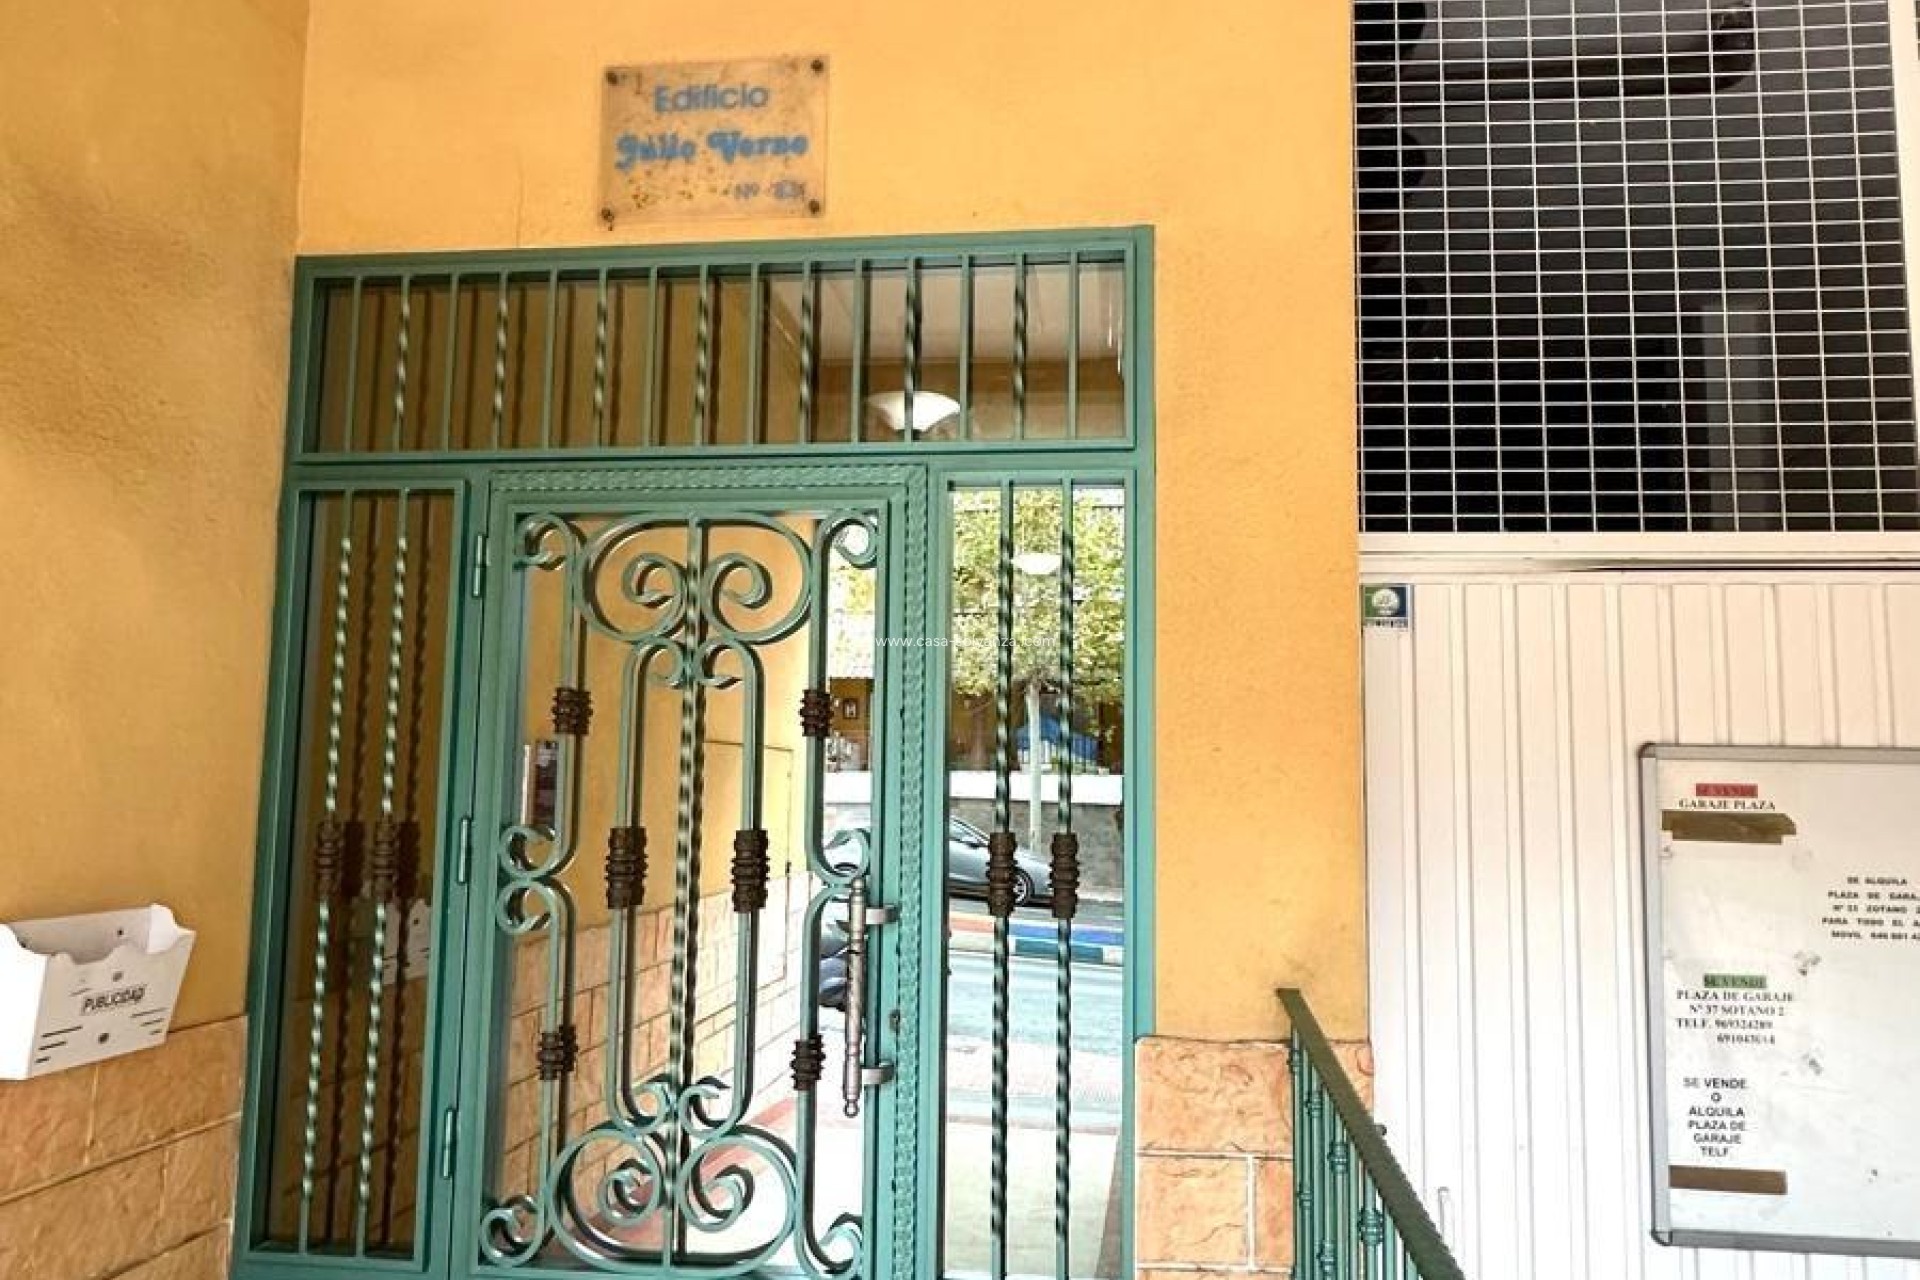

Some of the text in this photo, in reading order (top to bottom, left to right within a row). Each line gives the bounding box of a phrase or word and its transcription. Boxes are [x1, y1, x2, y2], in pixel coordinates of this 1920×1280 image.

[654, 83, 769, 112] Edificio
[707, 129, 808, 163] Verne
[1679, 799, 1775, 810] GARAJE PLAZA
[1828, 891, 1859, 899] PLAZA
[1822, 917, 1848, 925] PARA
[1677, 990, 1793, 1002] PLAZA DE GARAJE
[1683, 1077, 1748, 1089] SE VENDE
[1711, 1092, 1722, 1103] O
[1689, 1106, 1745, 1117] ALQUILA
[1688, 1120, 1747, 1131] PLAZA DE
[1693, 1133, 1742, 1144] GARAJE
